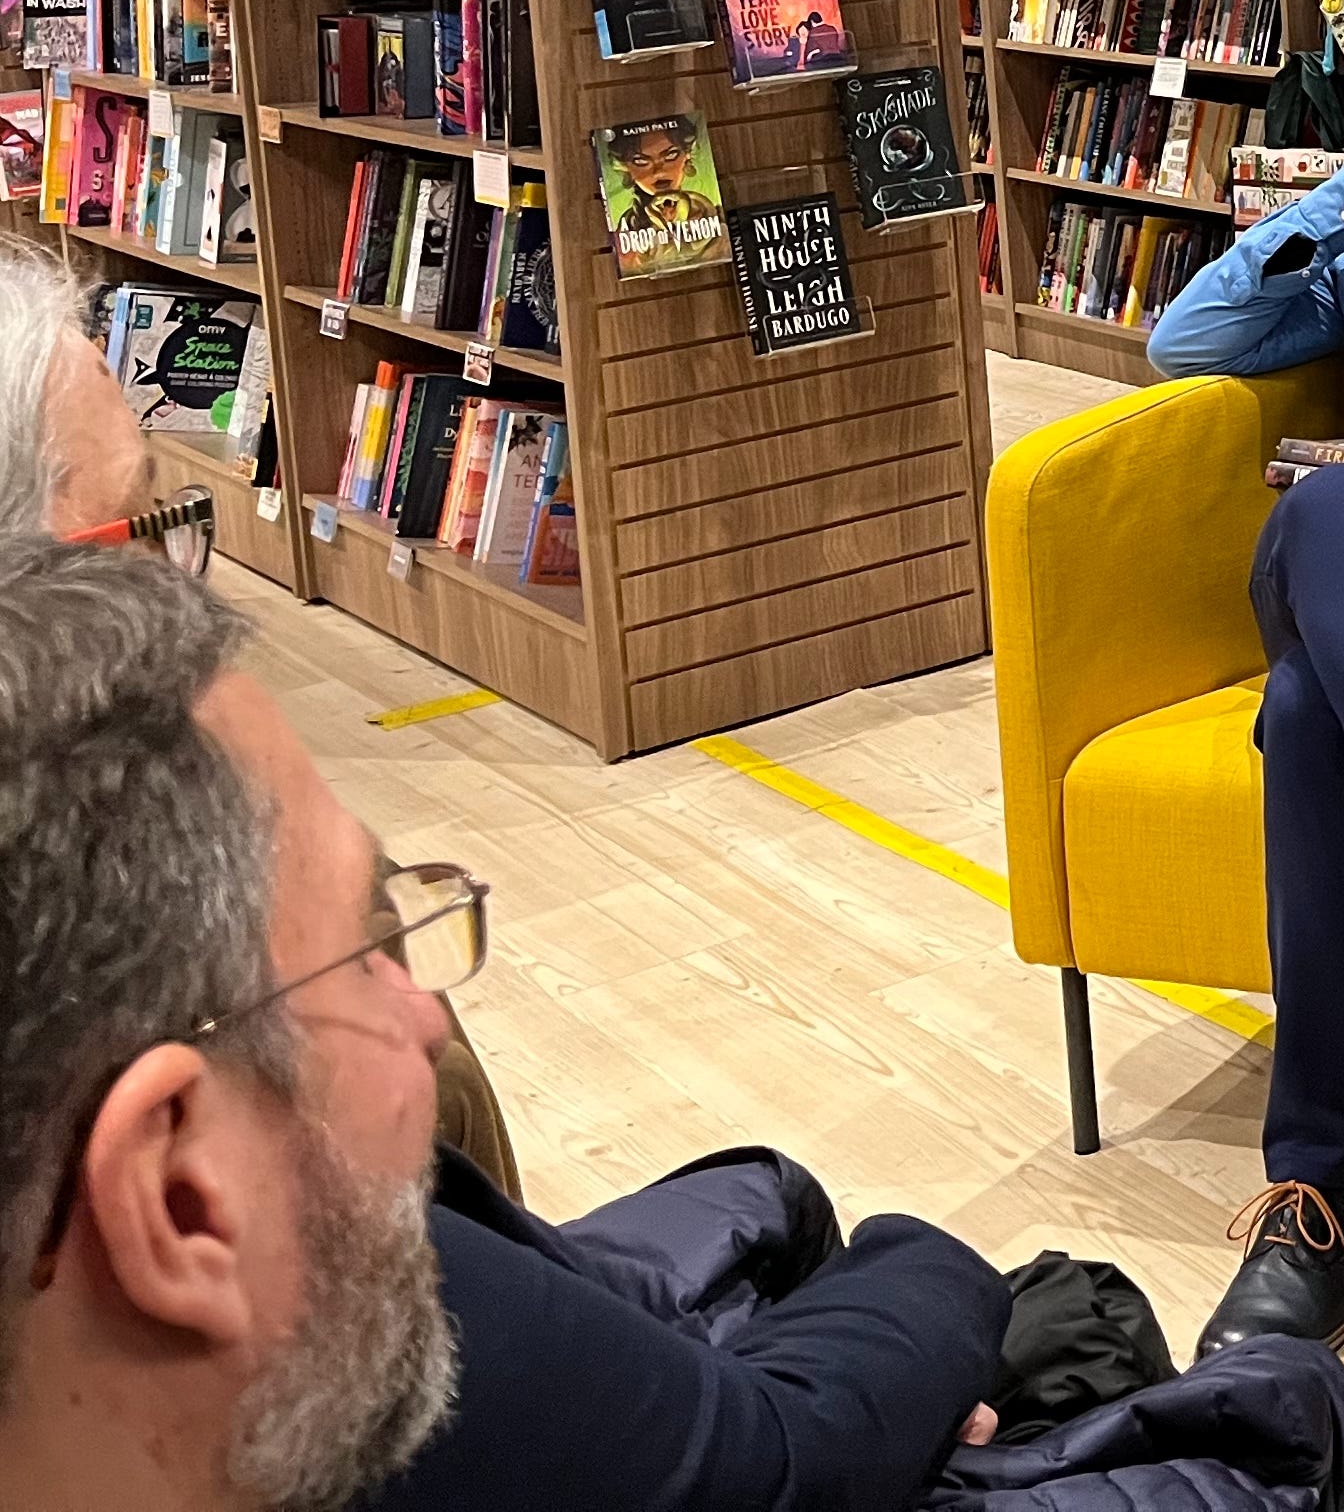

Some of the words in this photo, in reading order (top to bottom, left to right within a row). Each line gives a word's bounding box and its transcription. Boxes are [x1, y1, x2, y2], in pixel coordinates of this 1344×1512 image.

[27, 0, 38, 7] IN
[740, 7, 779, 29] LOVE
[743, 22, 792, 48] STORY
[856, 85, 937, 140] SKYSHADE
[623, 125, 651, 137] SAINI
[652, 119, 678, 131] PATEL
[618, 227, 658, 256] DROP
[658, 230, 669, 245] OF
[669, 215, 722, 252] VENOM
[621, 216, 630, 232] A
[754, 206, 831, 243] NINTH
[759, 237, 836, 274] HOUSE
[766, 276, 845, 315] LEIGH
[771, 307, 851, 338] BARDUGO
[184, 336, 233, 355] Space
[173, 352, 240, 371] Station
